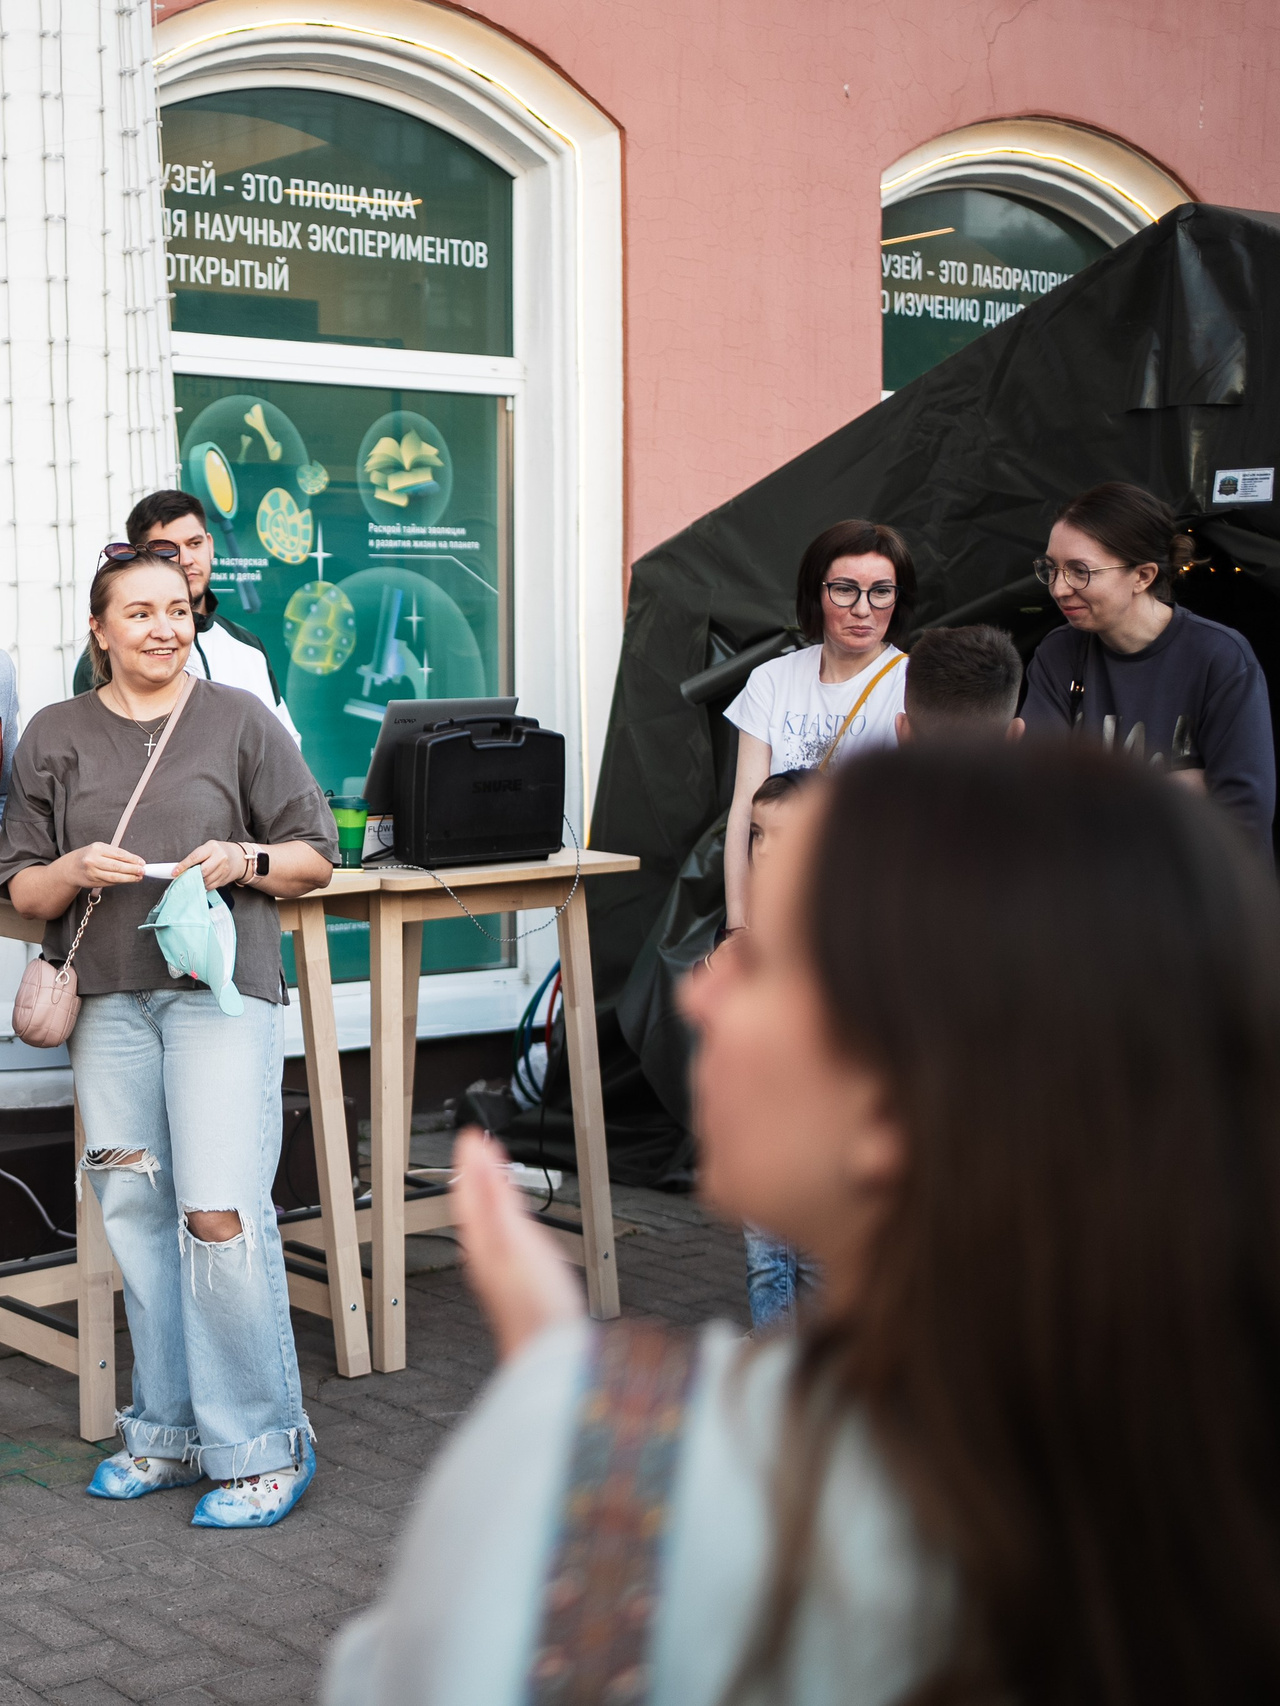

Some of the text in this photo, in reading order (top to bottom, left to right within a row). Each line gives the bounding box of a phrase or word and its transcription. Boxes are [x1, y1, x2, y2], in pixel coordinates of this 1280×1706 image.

[241, 172, 283, 204] ЭТО
[289, 178, 417, 221] ПЛОЩАДКА
[194, 211, 302, 250] НАУЧНЫХ
[307, 223, 489, 269] ЭКСПЕРИМЕНТОВ
[938, 260, 968, 287] ЭТО
[971, 263, 1075, 294] ЛАБОРАТОР
[893, 291, 980, 323] ИЗУЧЕНИЮ
[982, 301, 1026, 328] ДИН
[219, 558, 269, 568] мастерская
[236, 570, 262, 581] детей
[393, 717, 417, 725] Lenovo
[471, 778, 523, 794] SHURE
[367, 824, 394, 833] FLOW
